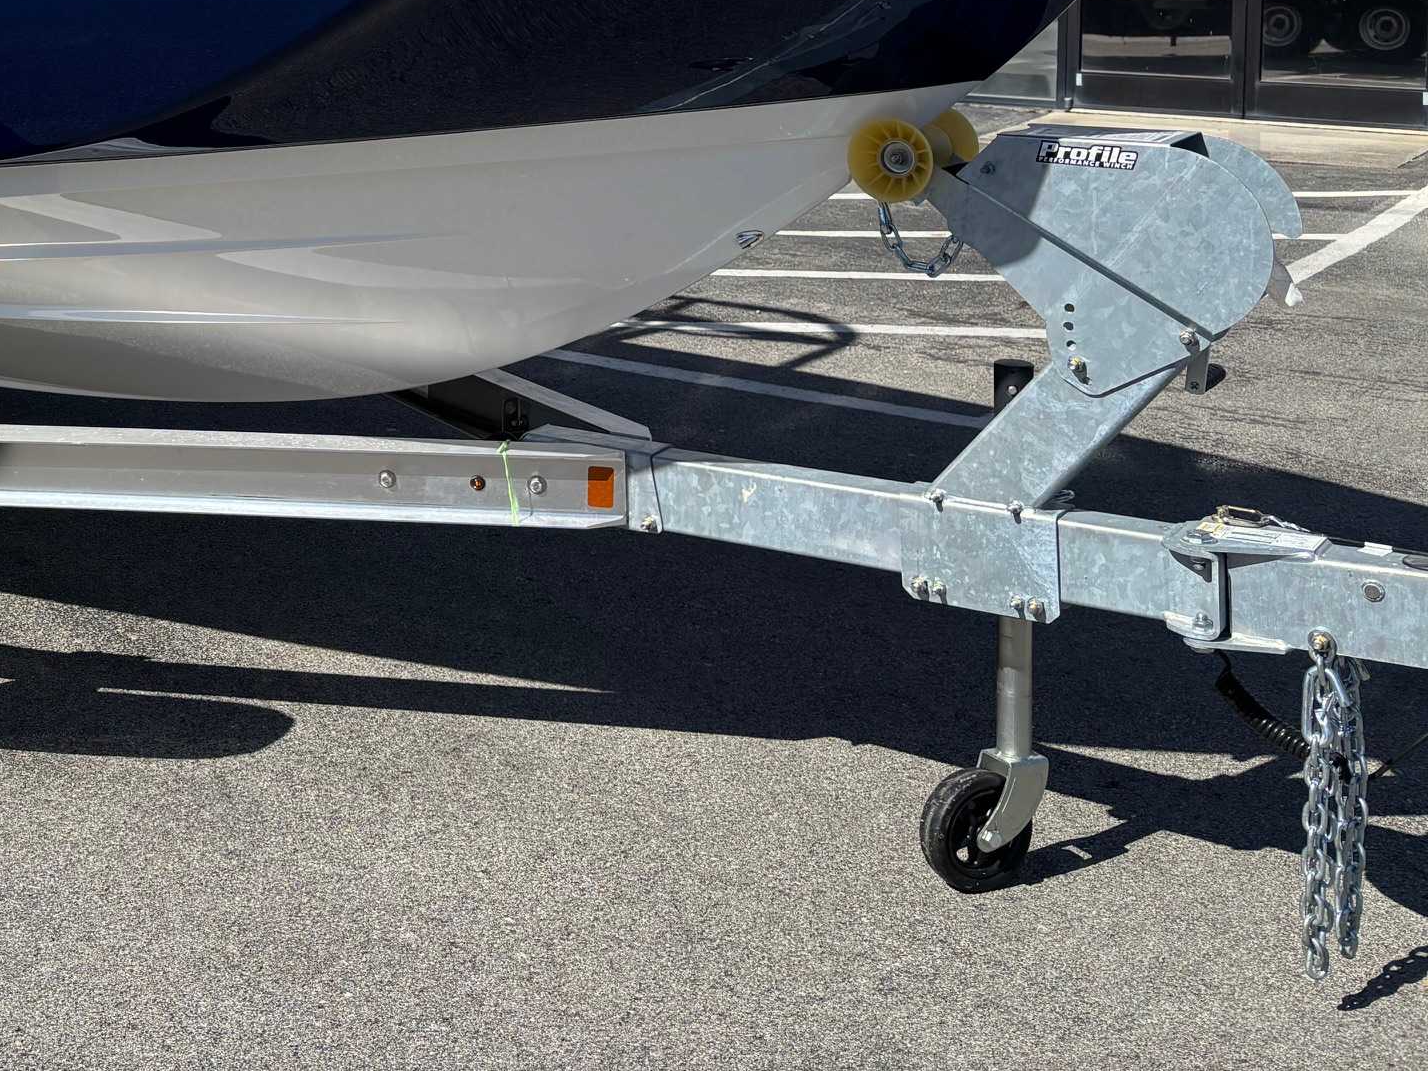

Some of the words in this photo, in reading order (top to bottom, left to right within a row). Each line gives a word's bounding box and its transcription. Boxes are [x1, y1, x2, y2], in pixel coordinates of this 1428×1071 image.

[1039, 141, 1138, 163] Profile
[1038, 156, 1100, 167] PERFORMANCE
[1103, 161, 1135, 170] WINCH
